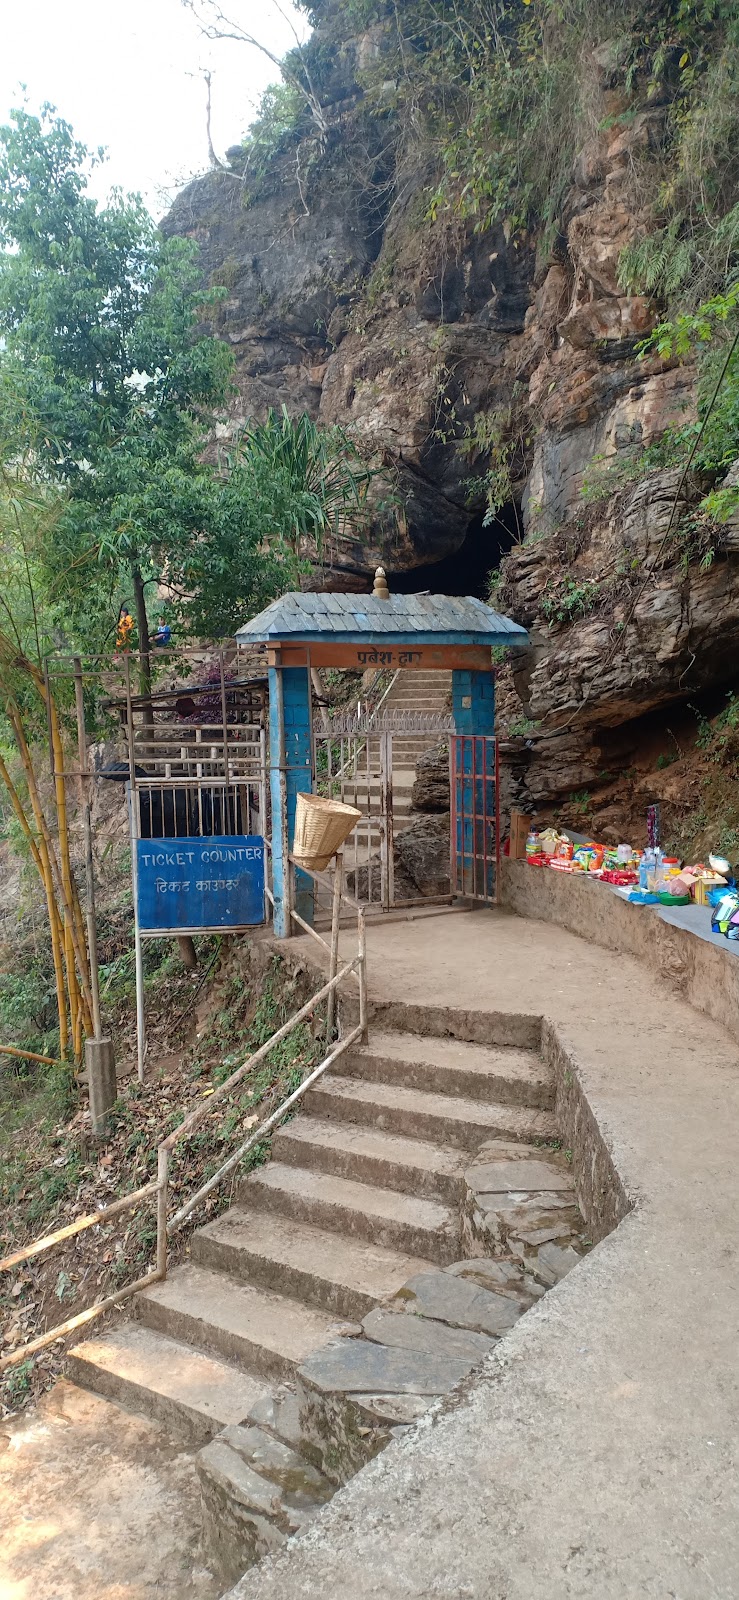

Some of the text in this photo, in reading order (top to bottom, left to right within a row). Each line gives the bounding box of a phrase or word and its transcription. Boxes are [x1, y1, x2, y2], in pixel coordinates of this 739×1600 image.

[141, 847, 262, 867] TICKET COUNTER
[154, 877, 190, 893] टिकट
